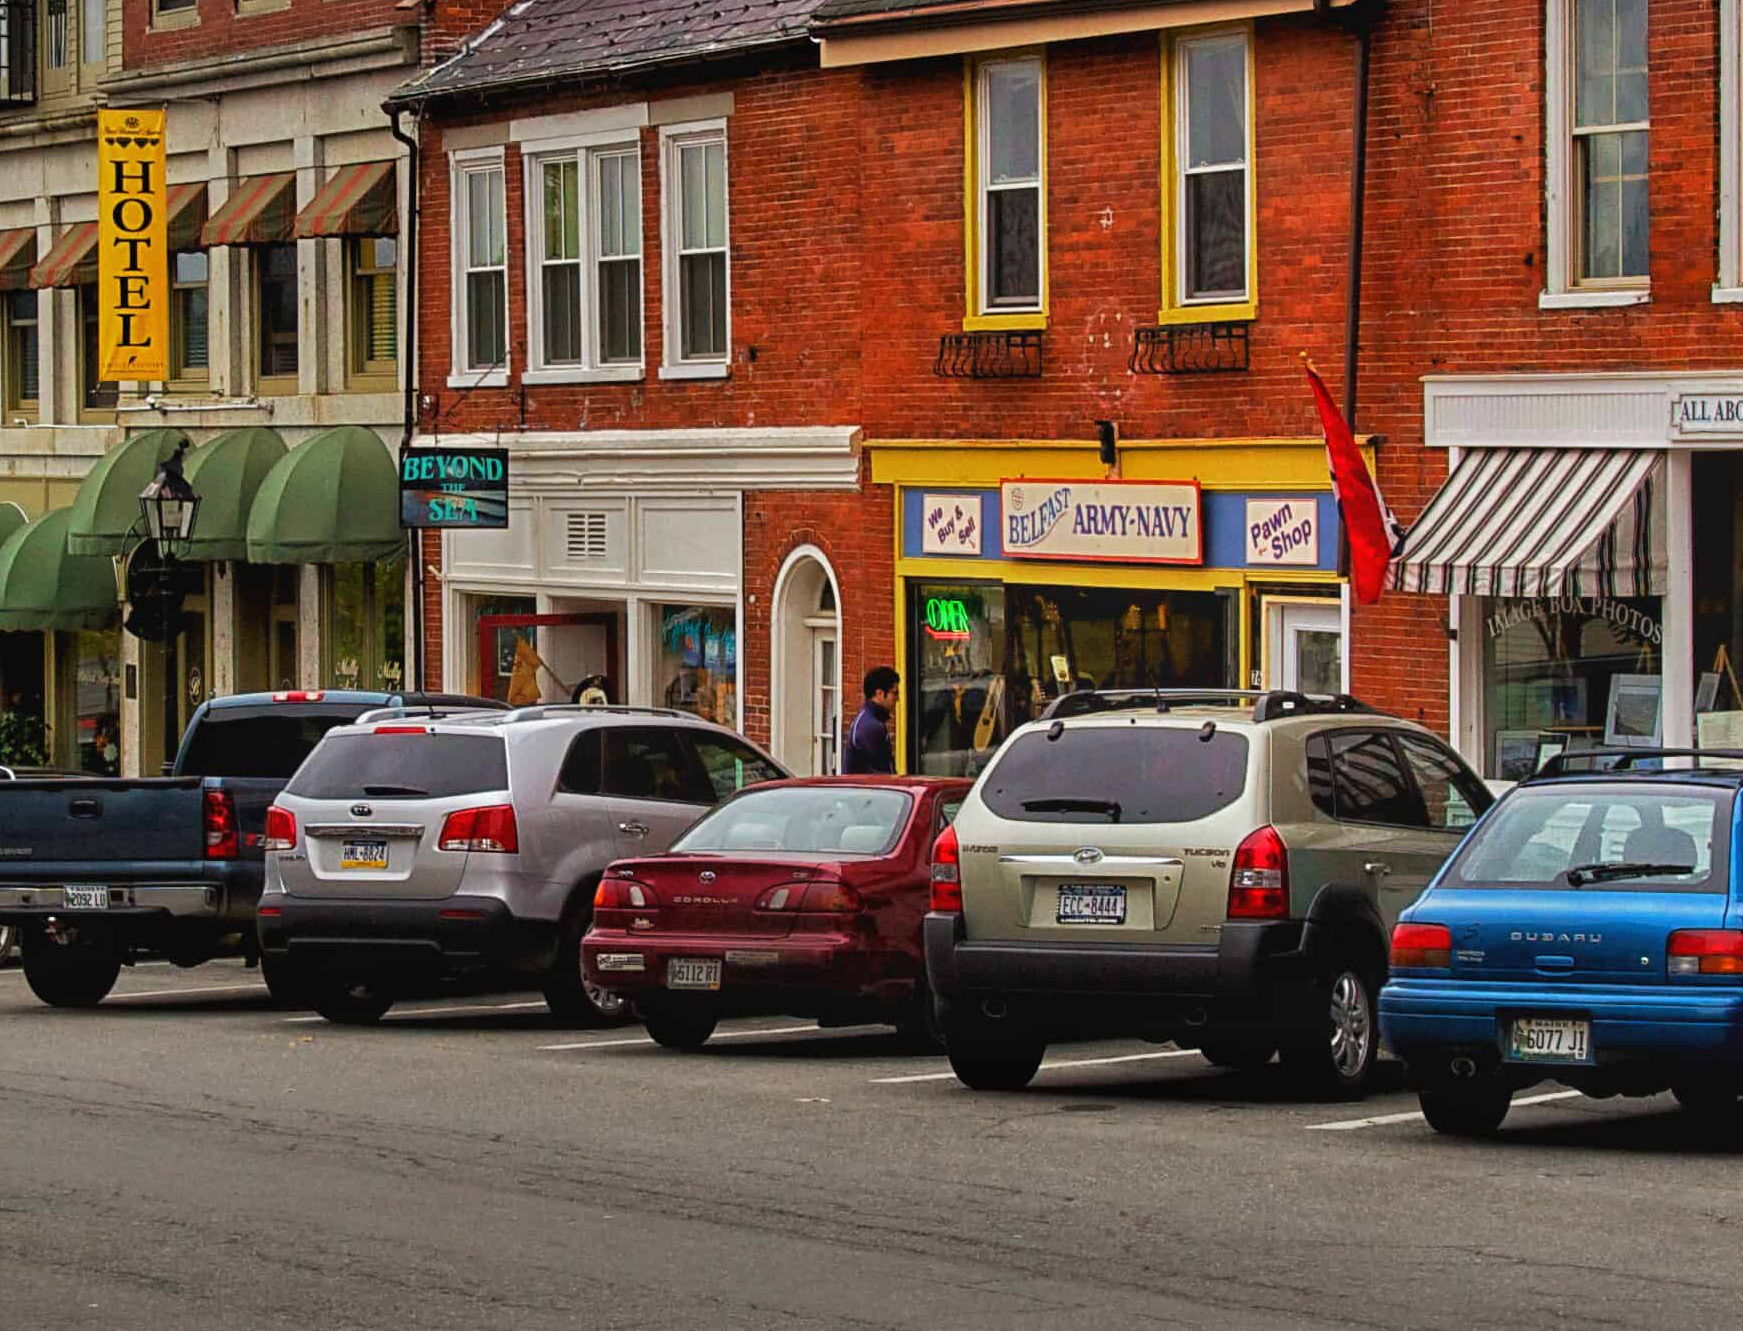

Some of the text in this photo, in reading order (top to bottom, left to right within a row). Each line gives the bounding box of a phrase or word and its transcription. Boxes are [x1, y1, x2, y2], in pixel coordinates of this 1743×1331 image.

[109, 160, 155, 348] HOTEL
[1681, 400, 1712, 421] ALL
[403, 455, 503, 482] BEYOND
[441, 483, 466, 493] THE
[428, 497, 479, 522] SEA
[928, 507, 943, 529] We
[1008, 487, 1192, 545] BELFAST ARMY-NAVY
[938, 516, 955, 545] Buy
[958, 516, 976, 545] Sell
[1250, 503, 1293, 549] Pawn
[1271, 518, 1312, 559] Shop
[927, 599, 970, 633] OPEN
[1550, 597, 1586, 615] BOX
[1591, 598, 1664, 646] PHOTOS
[1510, 931, 1602, 942] SUBARU
[676, 963, 704, 982] 5112
[1526, 1029, 1563, 1051] 6077
